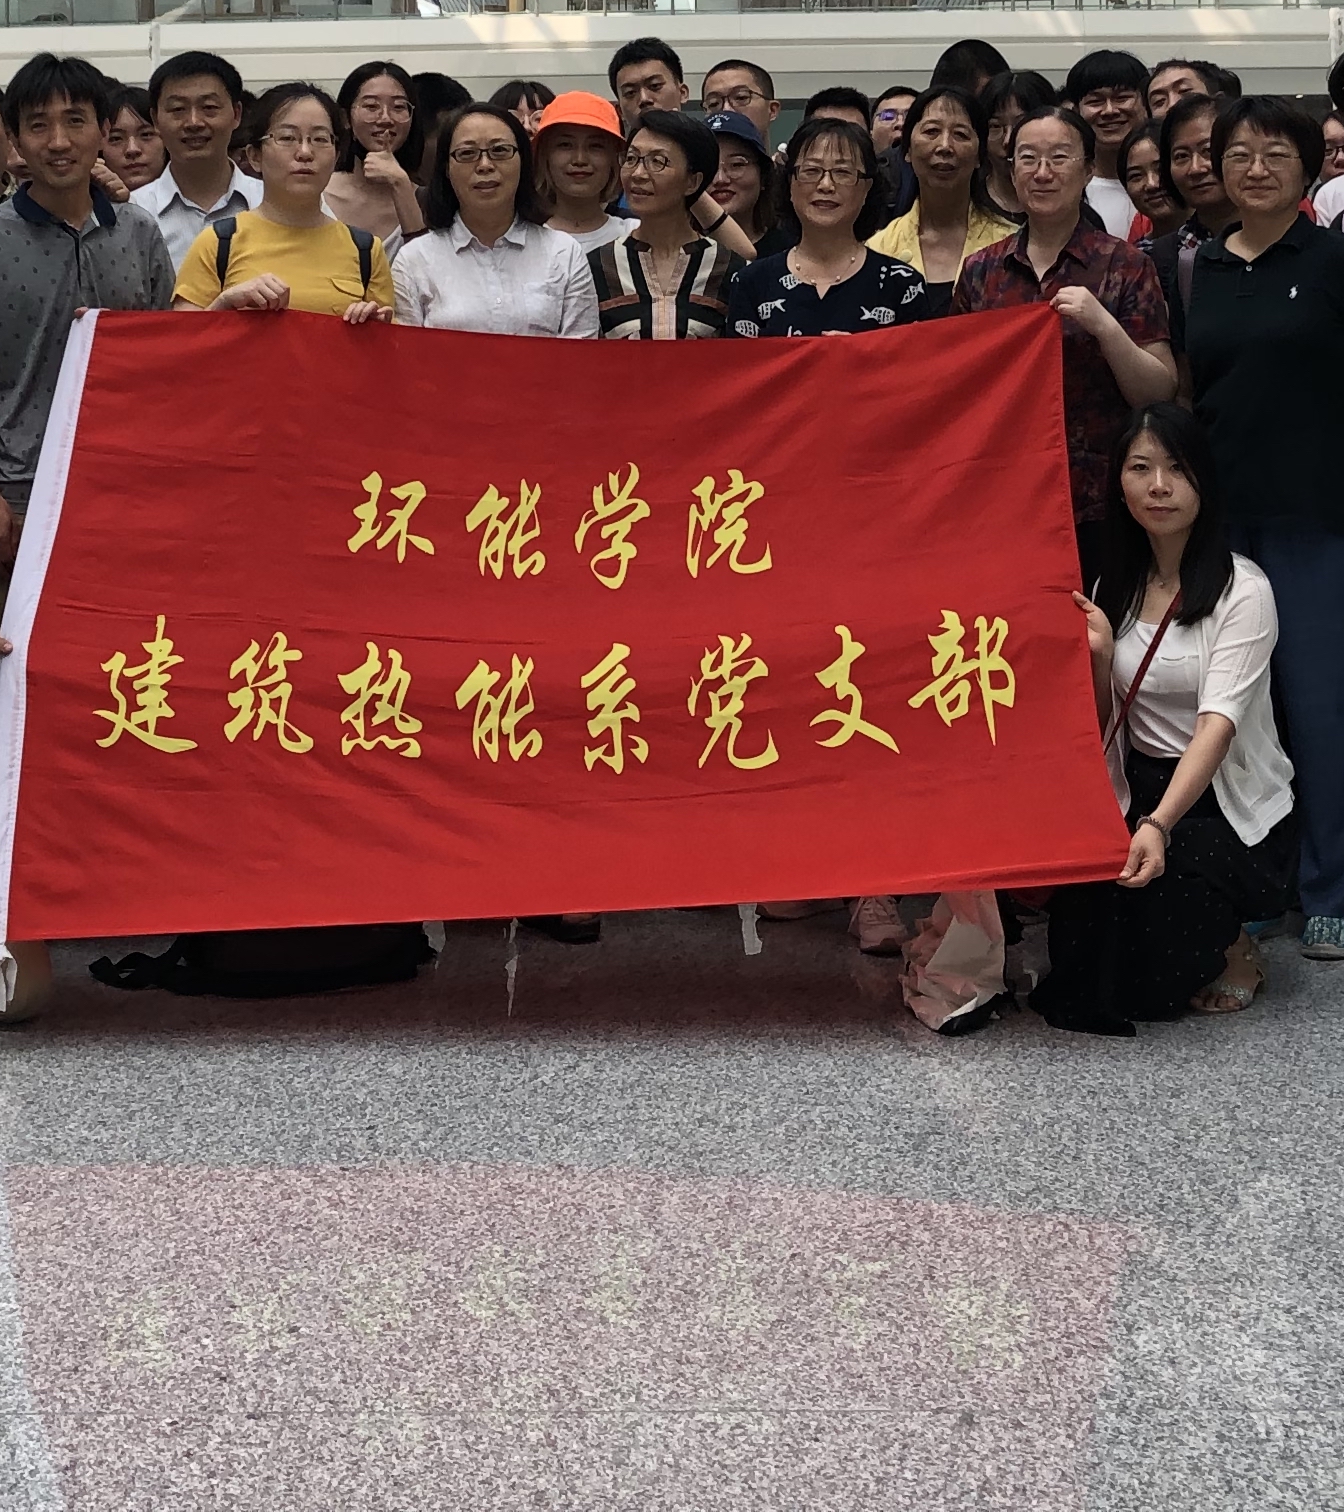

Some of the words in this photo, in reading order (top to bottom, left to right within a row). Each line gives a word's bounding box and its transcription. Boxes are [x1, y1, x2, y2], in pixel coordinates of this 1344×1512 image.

[347, 464, 773, 589] 环能学院
[95, 610, 1015, 774] 建筑热能系党支部
